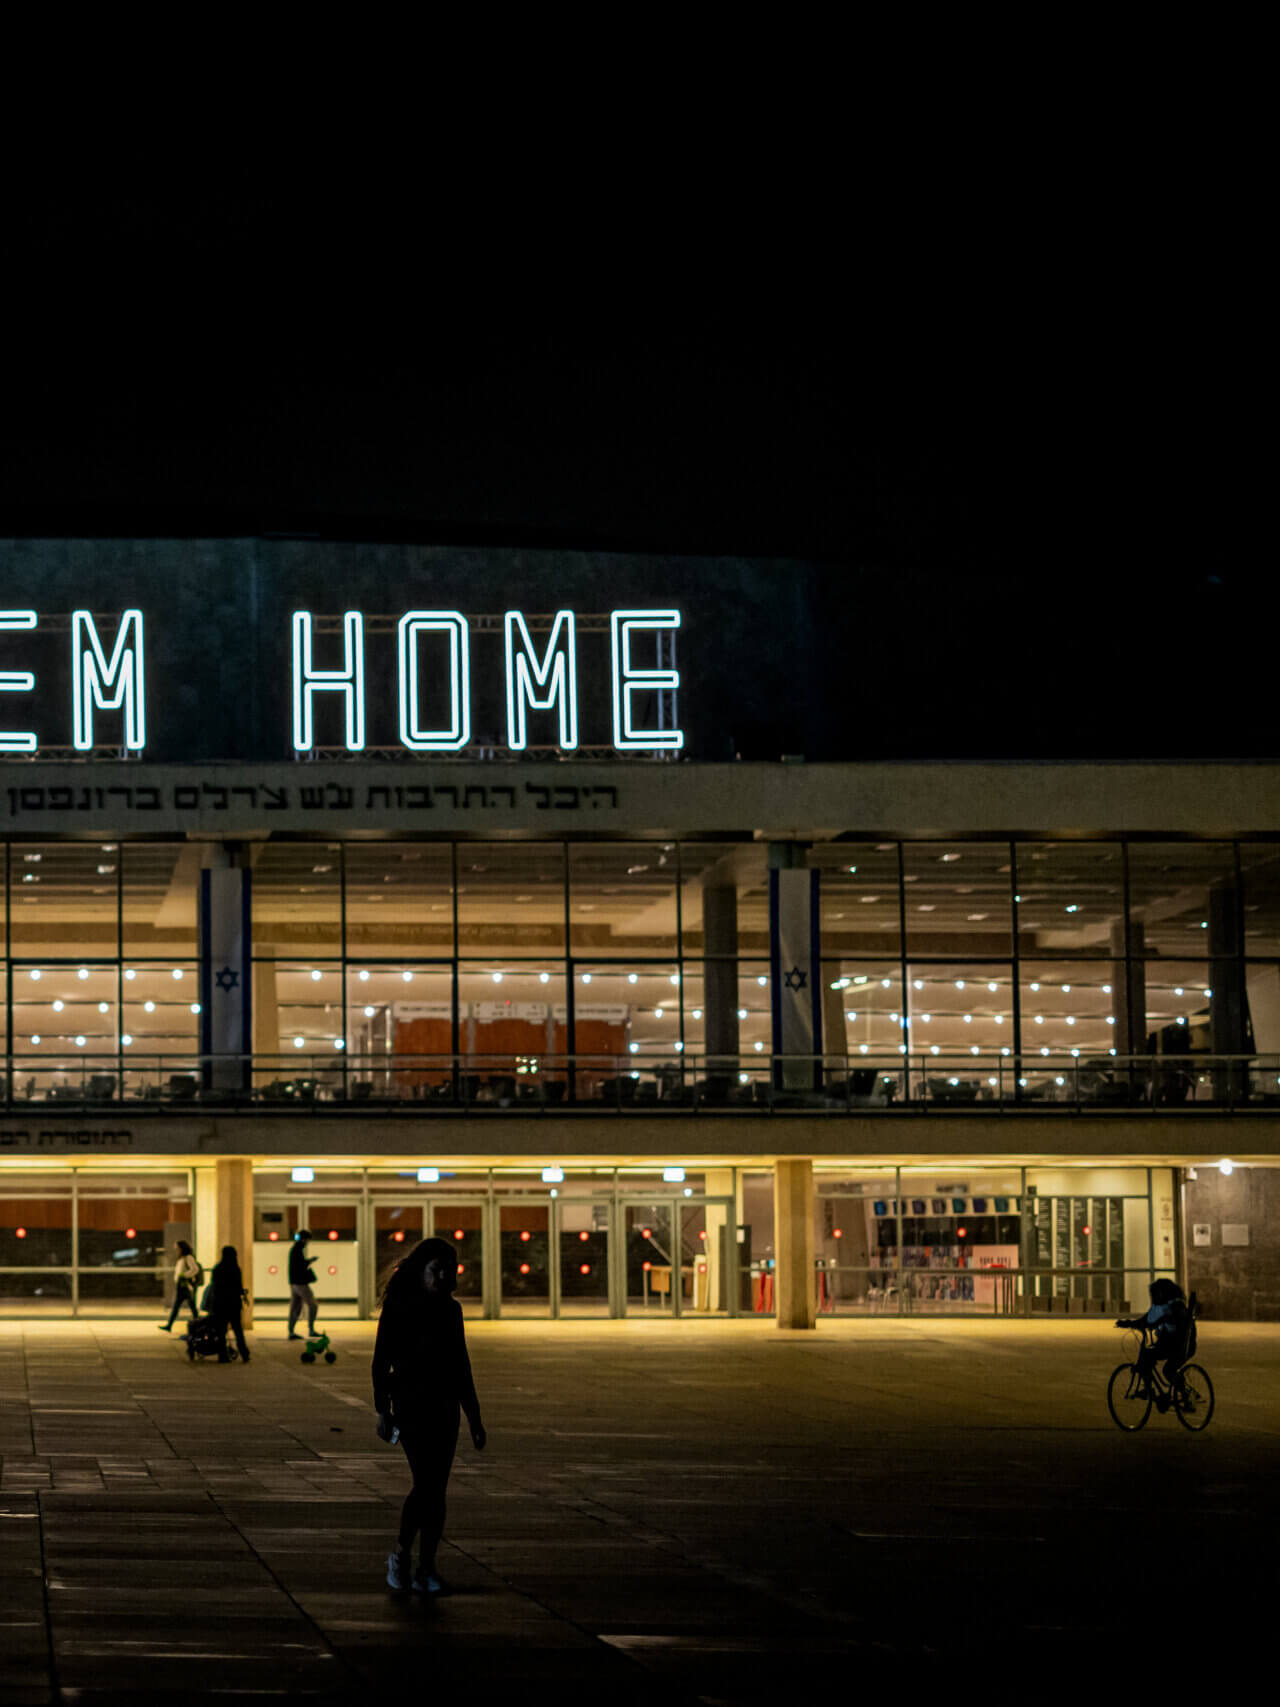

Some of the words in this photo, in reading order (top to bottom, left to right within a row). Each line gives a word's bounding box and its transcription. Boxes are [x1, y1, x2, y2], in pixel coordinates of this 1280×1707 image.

[292, 609, 684, 750] HOME
[6, 786, 164, 817] ברונפמן
[366, 785, 516, 811] התרבות
[526, 781, 620, 811] היכל
